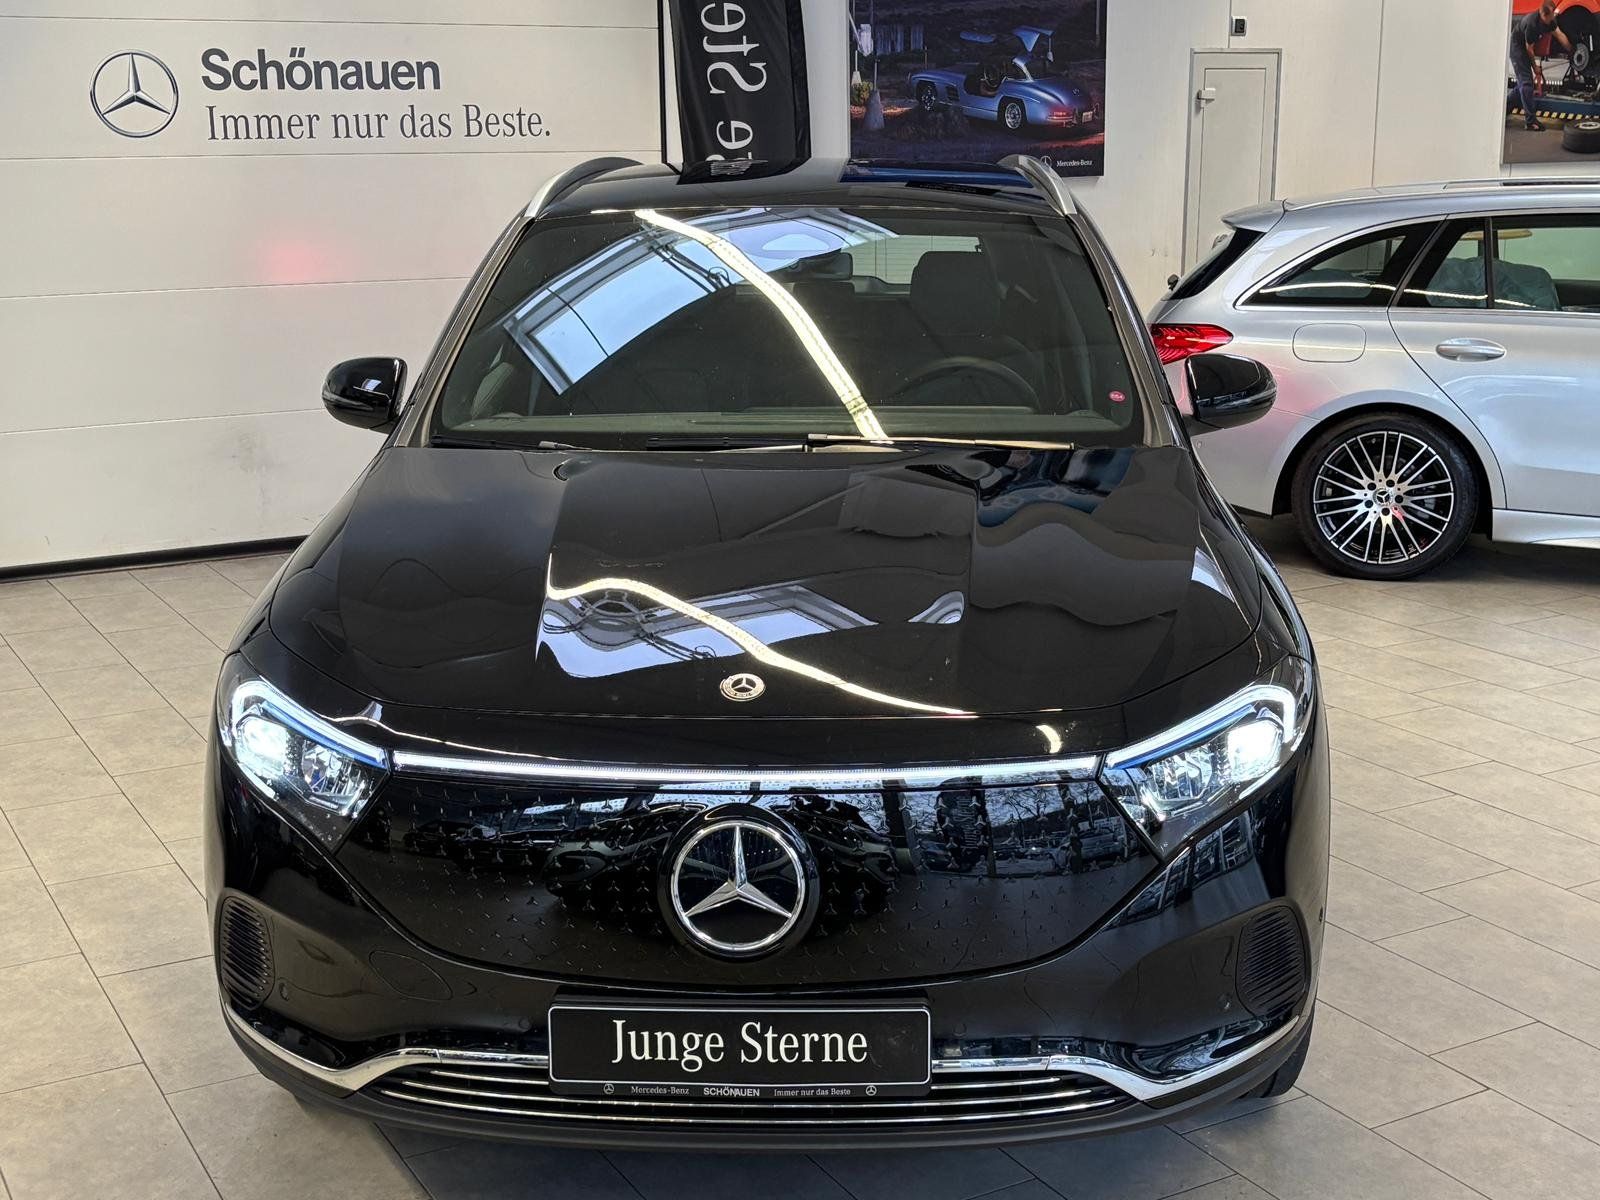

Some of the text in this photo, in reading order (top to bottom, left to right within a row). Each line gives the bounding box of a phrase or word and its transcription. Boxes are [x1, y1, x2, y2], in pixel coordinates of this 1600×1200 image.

[206, 104, 551, 141] Immer nur das Beste.
[611, 1019, 868, 1073] Junge Sterne
[631, 1086, 690, 1095] Mercedes-Benz
[703, 1086, 760, 1097] SCHÖNAUEN
[774, 1088, 799, 1097] Immer
[816, 1088, 829, 1096] das
[831, 1087, 851, 1096] Beste
